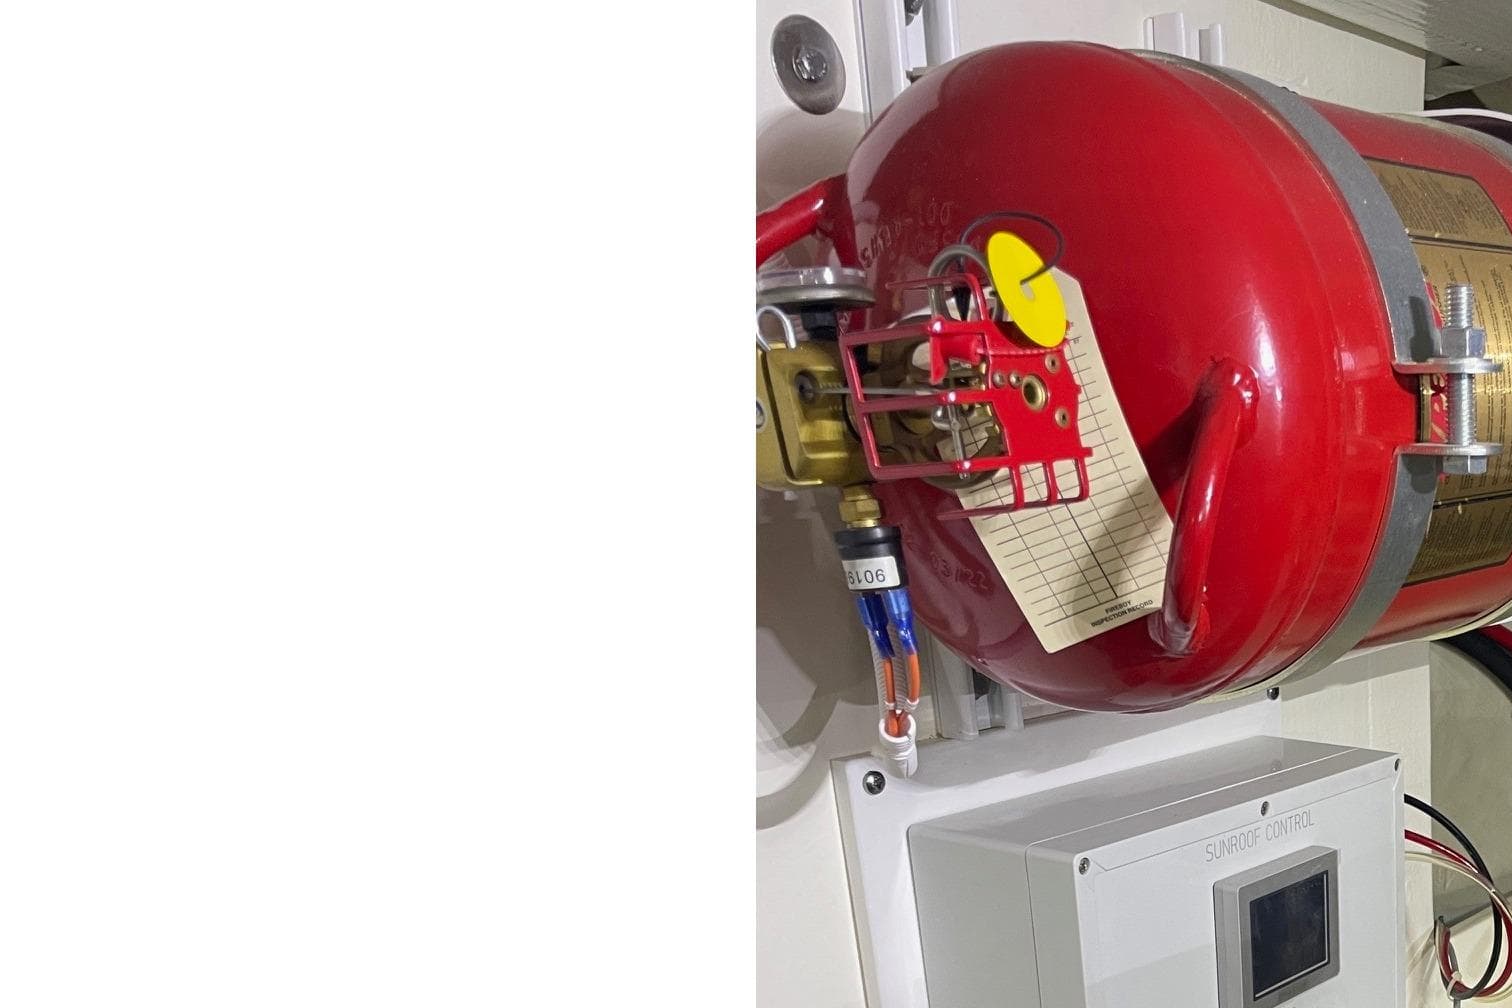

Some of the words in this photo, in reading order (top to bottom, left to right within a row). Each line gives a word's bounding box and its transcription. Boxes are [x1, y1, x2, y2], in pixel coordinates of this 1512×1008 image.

[1091, 609, 1128, 628] INSPECTION
[1128, 599, 1154, 615] RECORD
[1105, 600, 1131, 615] FIREBOY
[1205, 827, 1261, 863] SUNROOF
[1265, 809, 1316, 842] CONTROL
